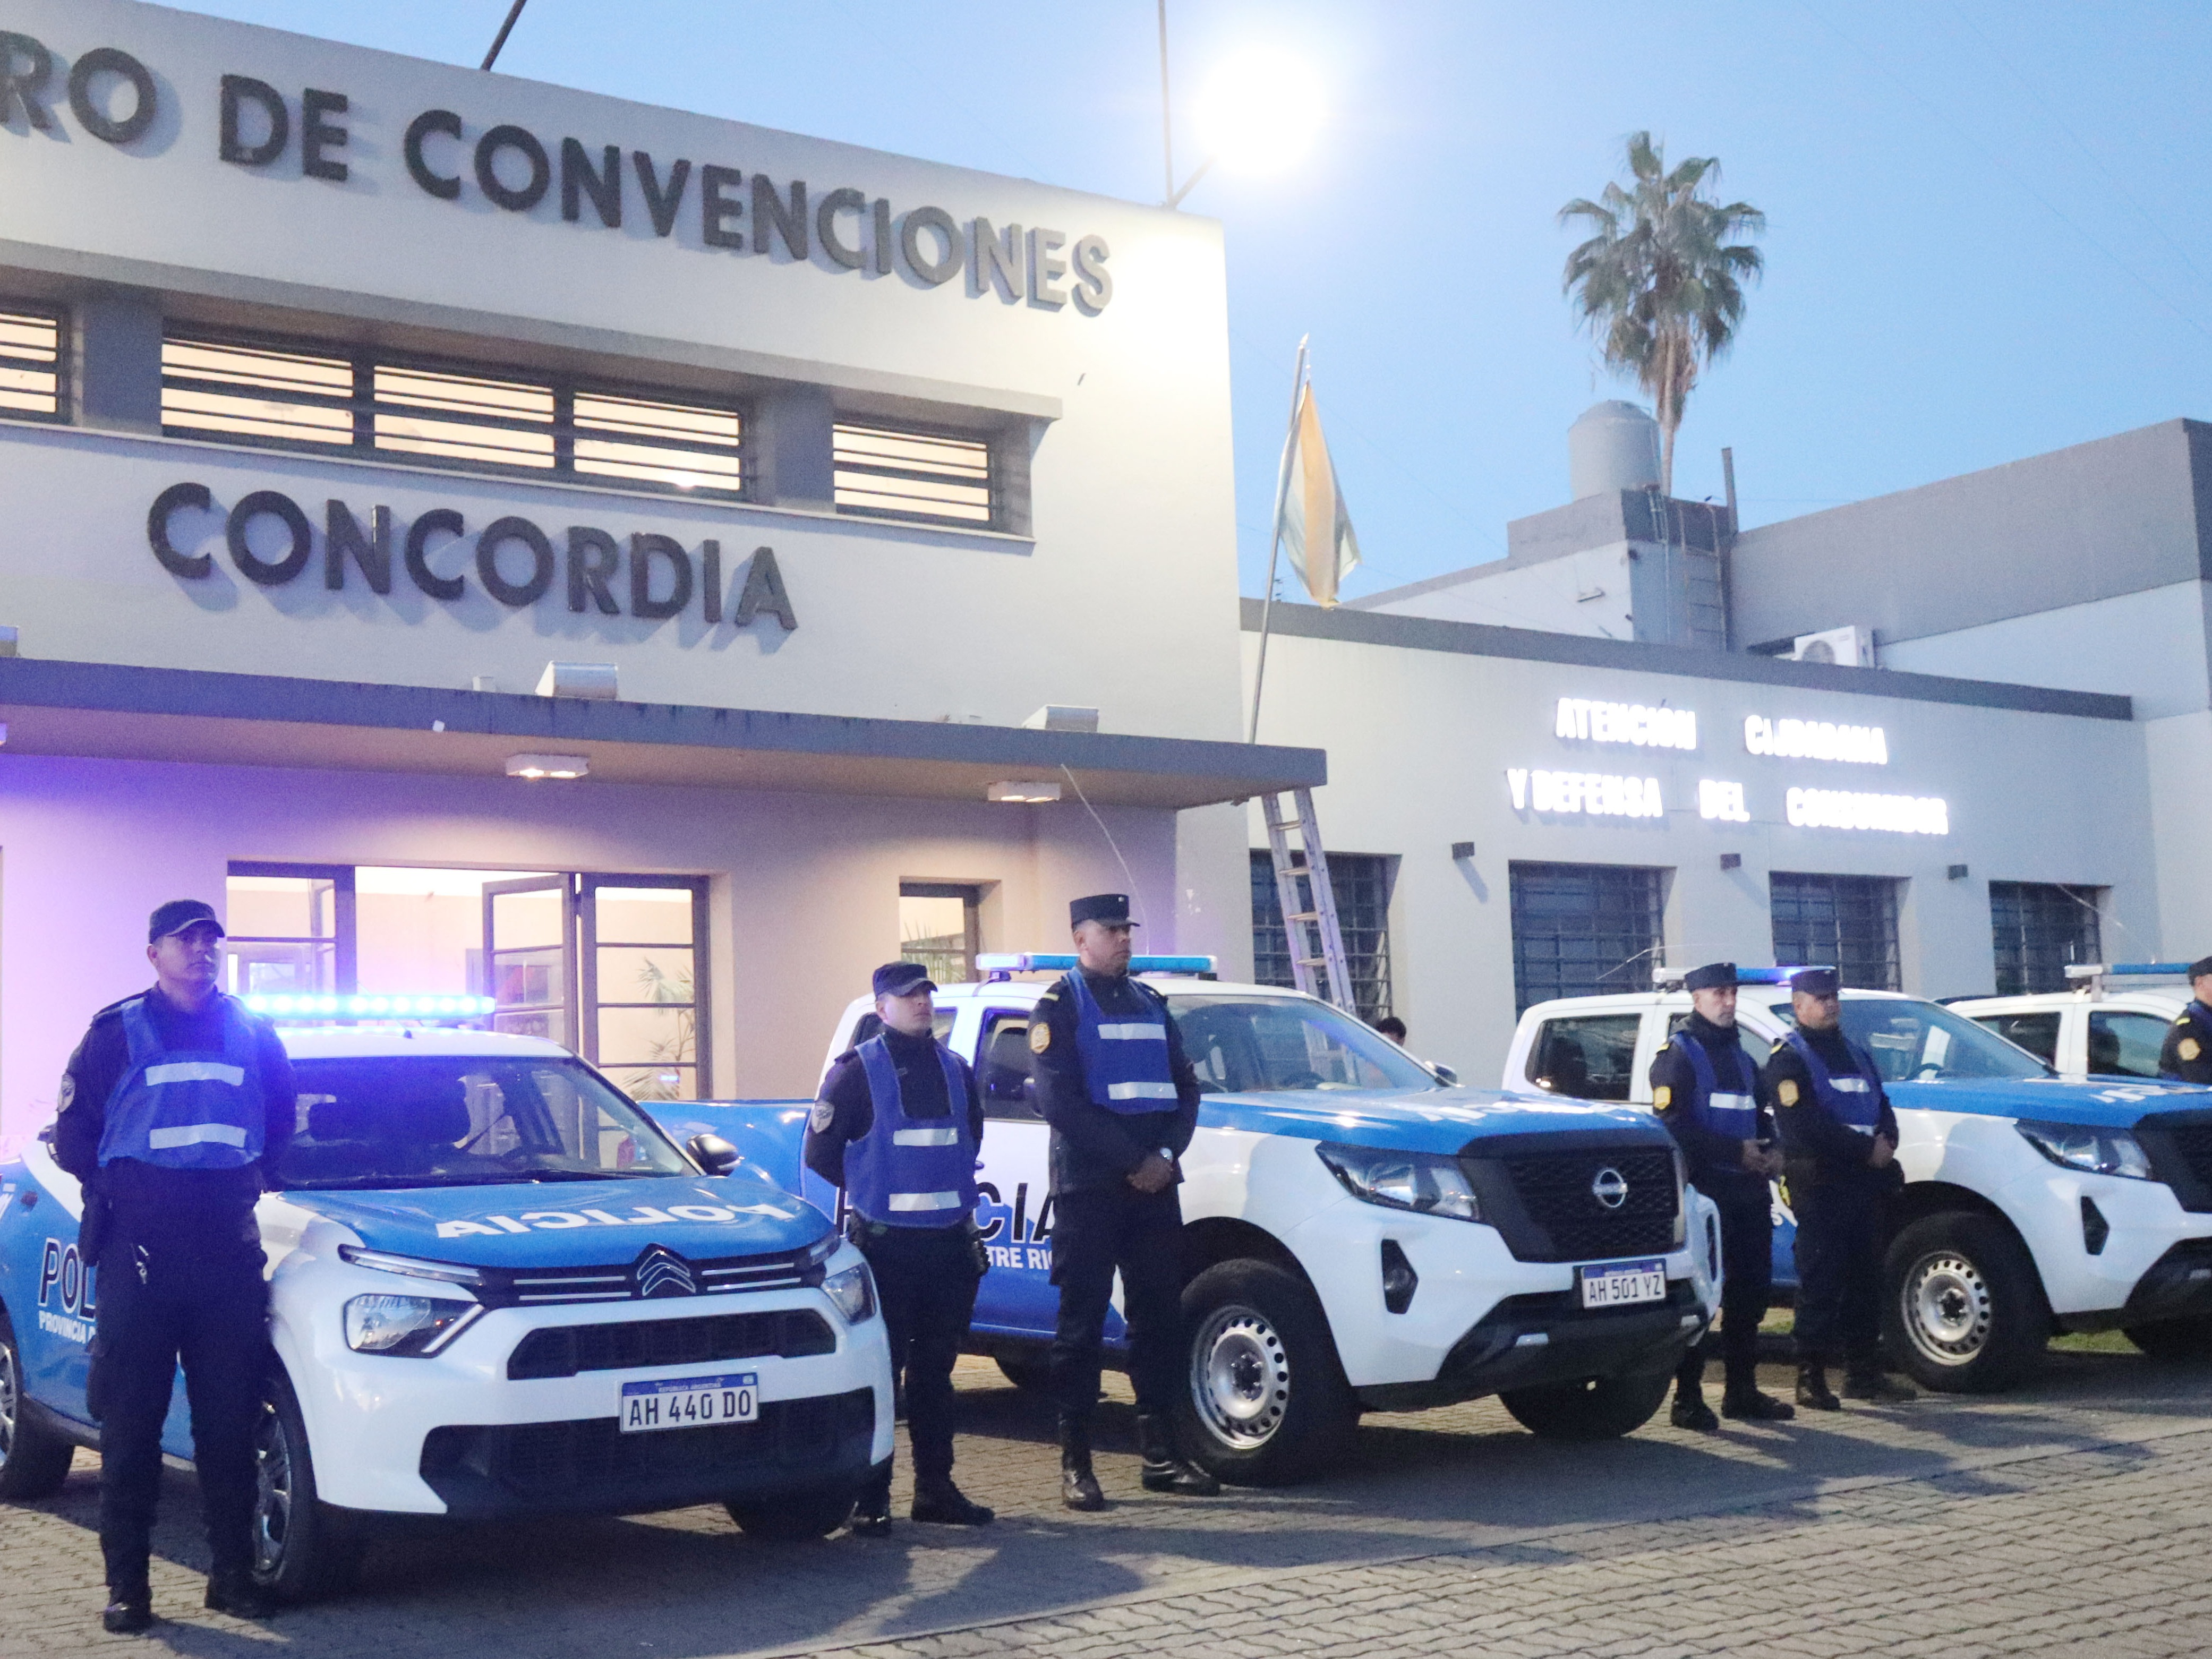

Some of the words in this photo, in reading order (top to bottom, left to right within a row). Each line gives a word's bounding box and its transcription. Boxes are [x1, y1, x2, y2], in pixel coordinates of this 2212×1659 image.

[219, 74, 348, 183] DE
[403, 109, 1113, 312] CONVENCIONES
[147, 481, 799, 630] CONCORDIA
[1507, 768, 1527, 809] Y
[1531, 769, 1663, 817] DEFENSA
[1699, 779, 1750, 823] DEL
[1590, 1280, 1607, 1301] AH
[1612, 1277, 1638, 1299] 501
[1644, 1275, 1661, 1296] YZ
[629, 1398, 658, 1426] AH
[669, 1393, 713, 1422] 440
